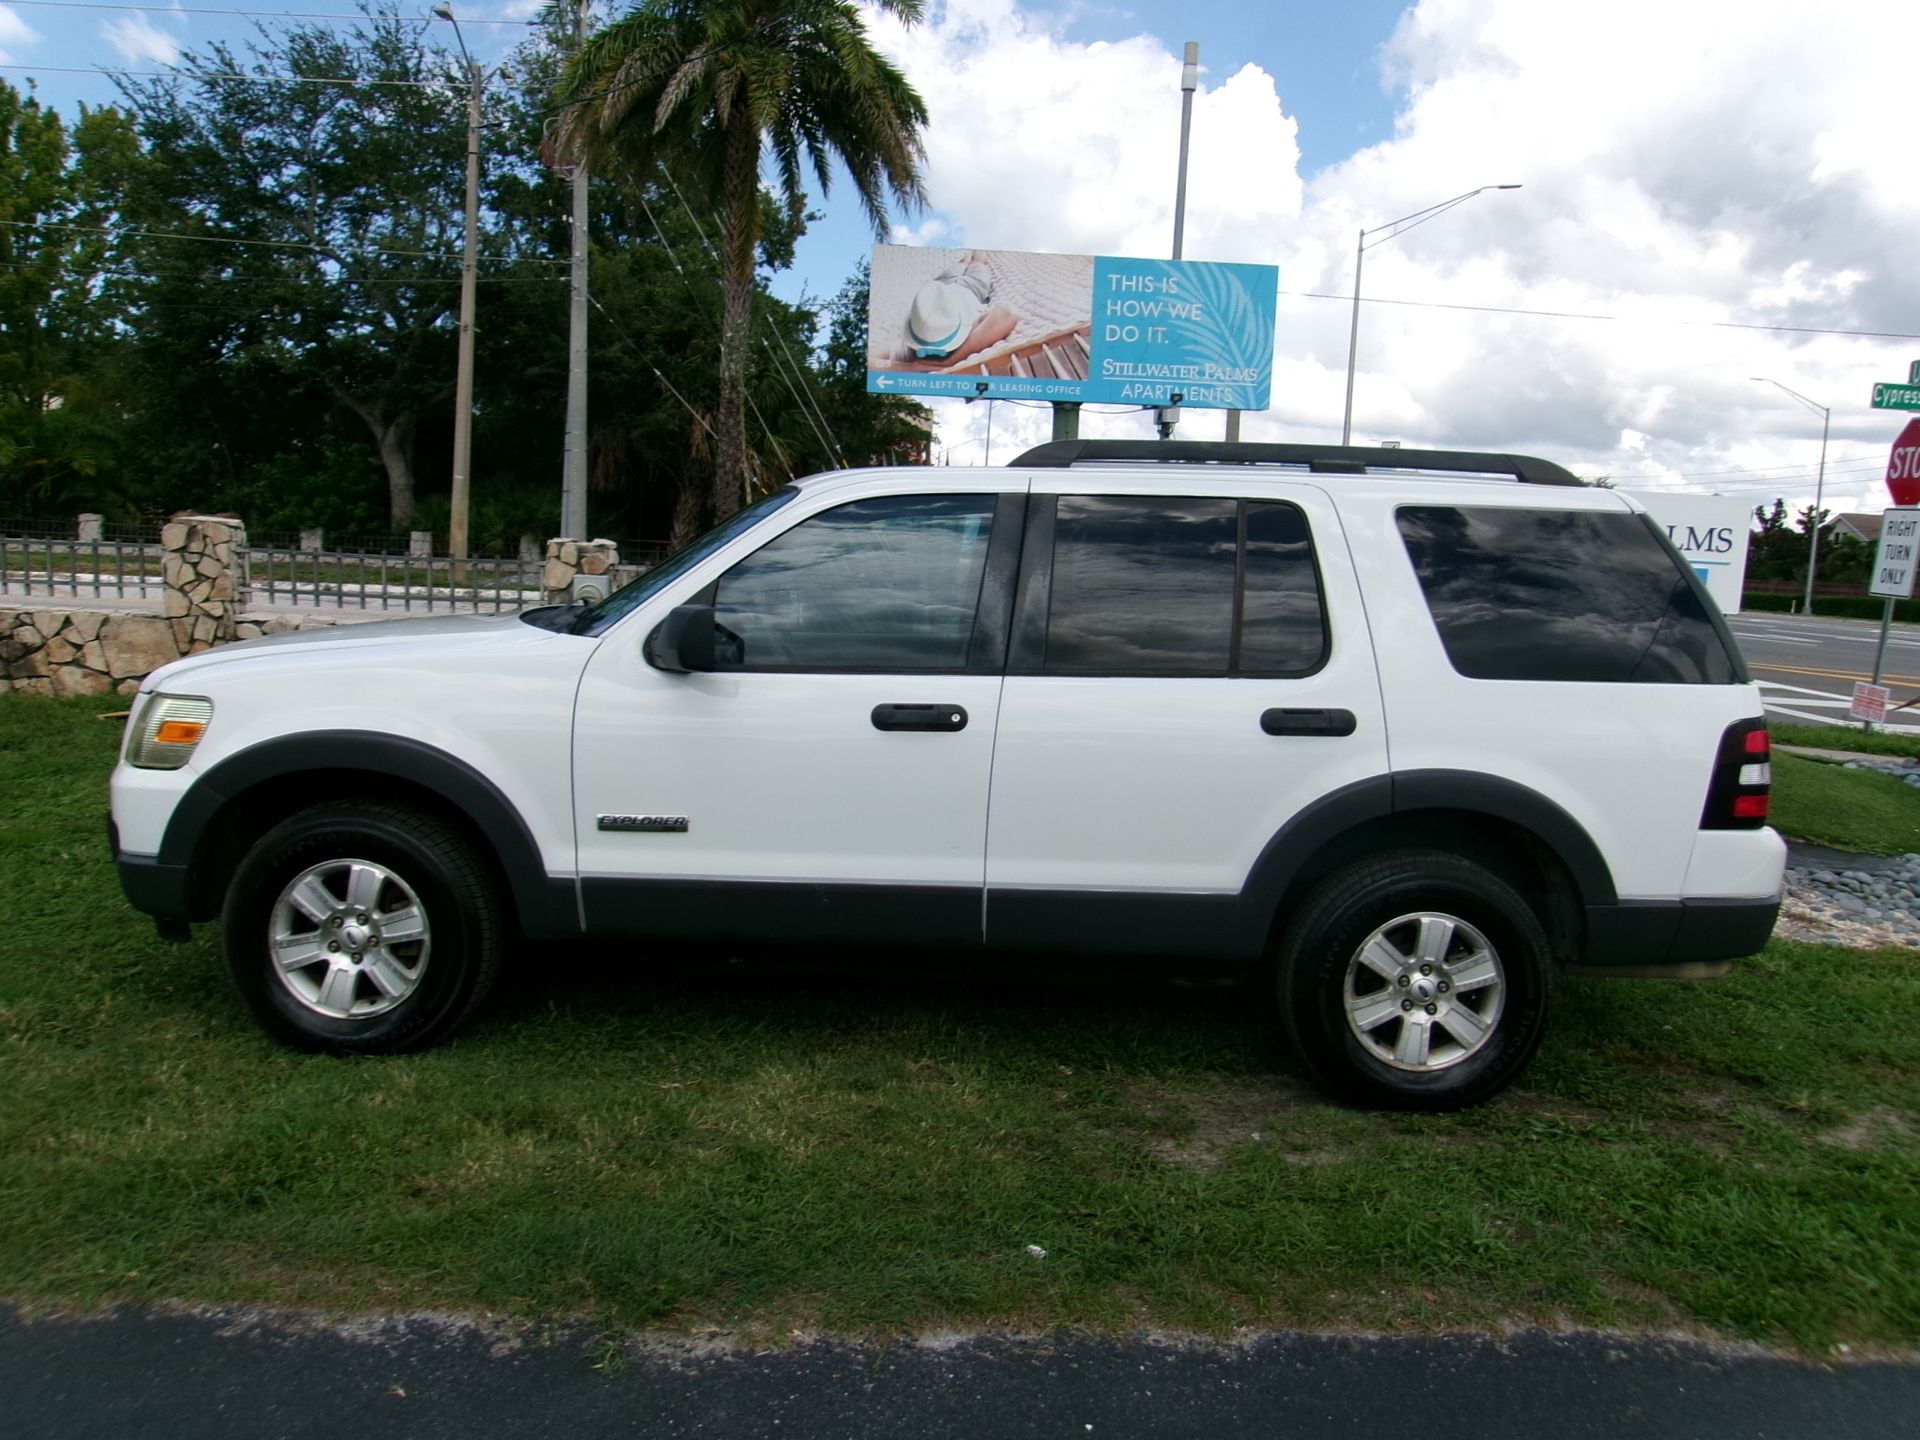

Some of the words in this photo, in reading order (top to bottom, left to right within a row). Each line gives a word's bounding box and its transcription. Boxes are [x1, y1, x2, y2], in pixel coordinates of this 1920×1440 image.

[1107, 273, 1154, 293] THIS
[1162, 276, 1179, 294] IS
[1106, 299, 1163, 318] HOW
[1168, 303, 1203, 320] WE
[1105, 324, 1139, 343] DO
[1147, 326, 1169, 344] IT.
[898, 378, 926, 388] TURN
[930, 380, 953, 389] LEFT
[956, 381, 970, 390] TO
[999, 383, 1043, 394] LEASING
[1046, 385, 1081, 395] OFFICE
[1121, 383, 1233, 402] APARTMENTS
[1886, 521, 1918, 536] RIGHT
[1885, 544, 1912, 560] TURN
[1880, 567, 1906, 584] ONLY
[598, 814, 689, 828] EXPLORER
